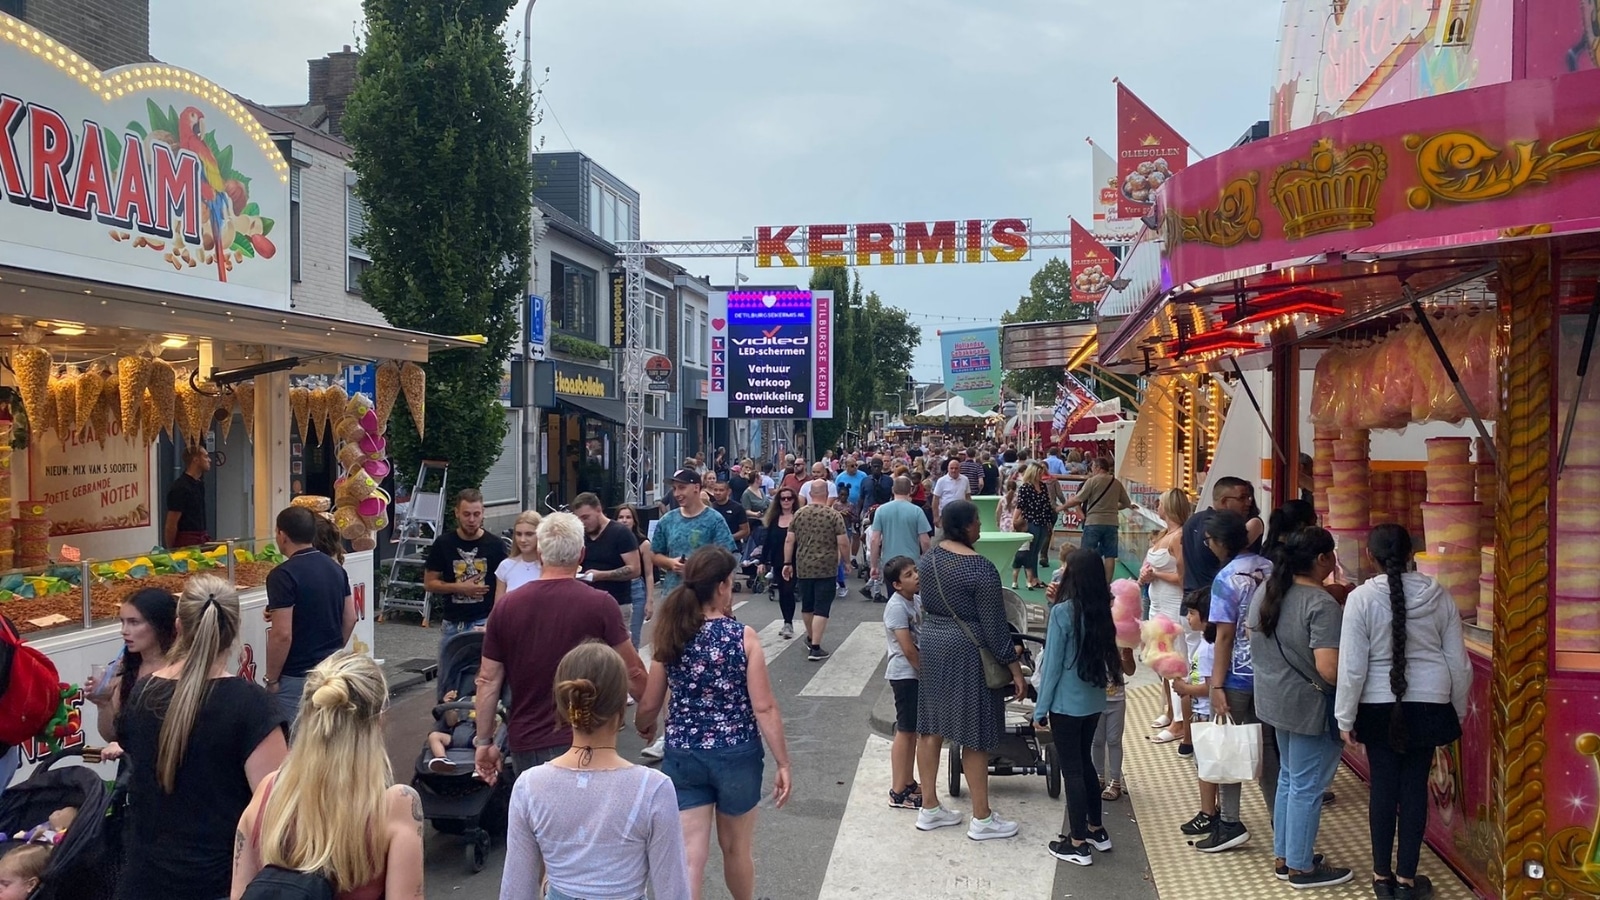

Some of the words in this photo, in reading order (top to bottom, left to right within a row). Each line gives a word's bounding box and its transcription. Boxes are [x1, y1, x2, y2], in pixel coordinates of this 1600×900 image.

[1121, 148, 1179, 158] OLIEBOLLEN
[757, 218, 1028, 267] KERMIS
[534, 299, 541, 317] P
[818, 302, 827, 362] TILBURGSE
[731, 336, 809, 345] vidiled
[738, 347, 805, 356] LED-schermen
[349, 364, 367, 383] P
[748, 364, 791, 373] Verhuur
[559, 371, 605, 397] kaasbolleke
[748, 378, 791, 389] Verkoop
[818, 367, 827, 407] KERMIS
[735, 391, 804, 403] Ontwikkeling
[745, 405, 794, 414] Productie
[45, 465, 71, 477] NIEUW:
[73, 464, 86, 475] MIX
[89, 464, 101, 474] VAN
[103, 464, 108, 474] 5
[109, 463, 138, 473] SOORTEN
[72, 477, 111, 498] GEBRANDE
[100, 482, 139, 508] NOTEN
